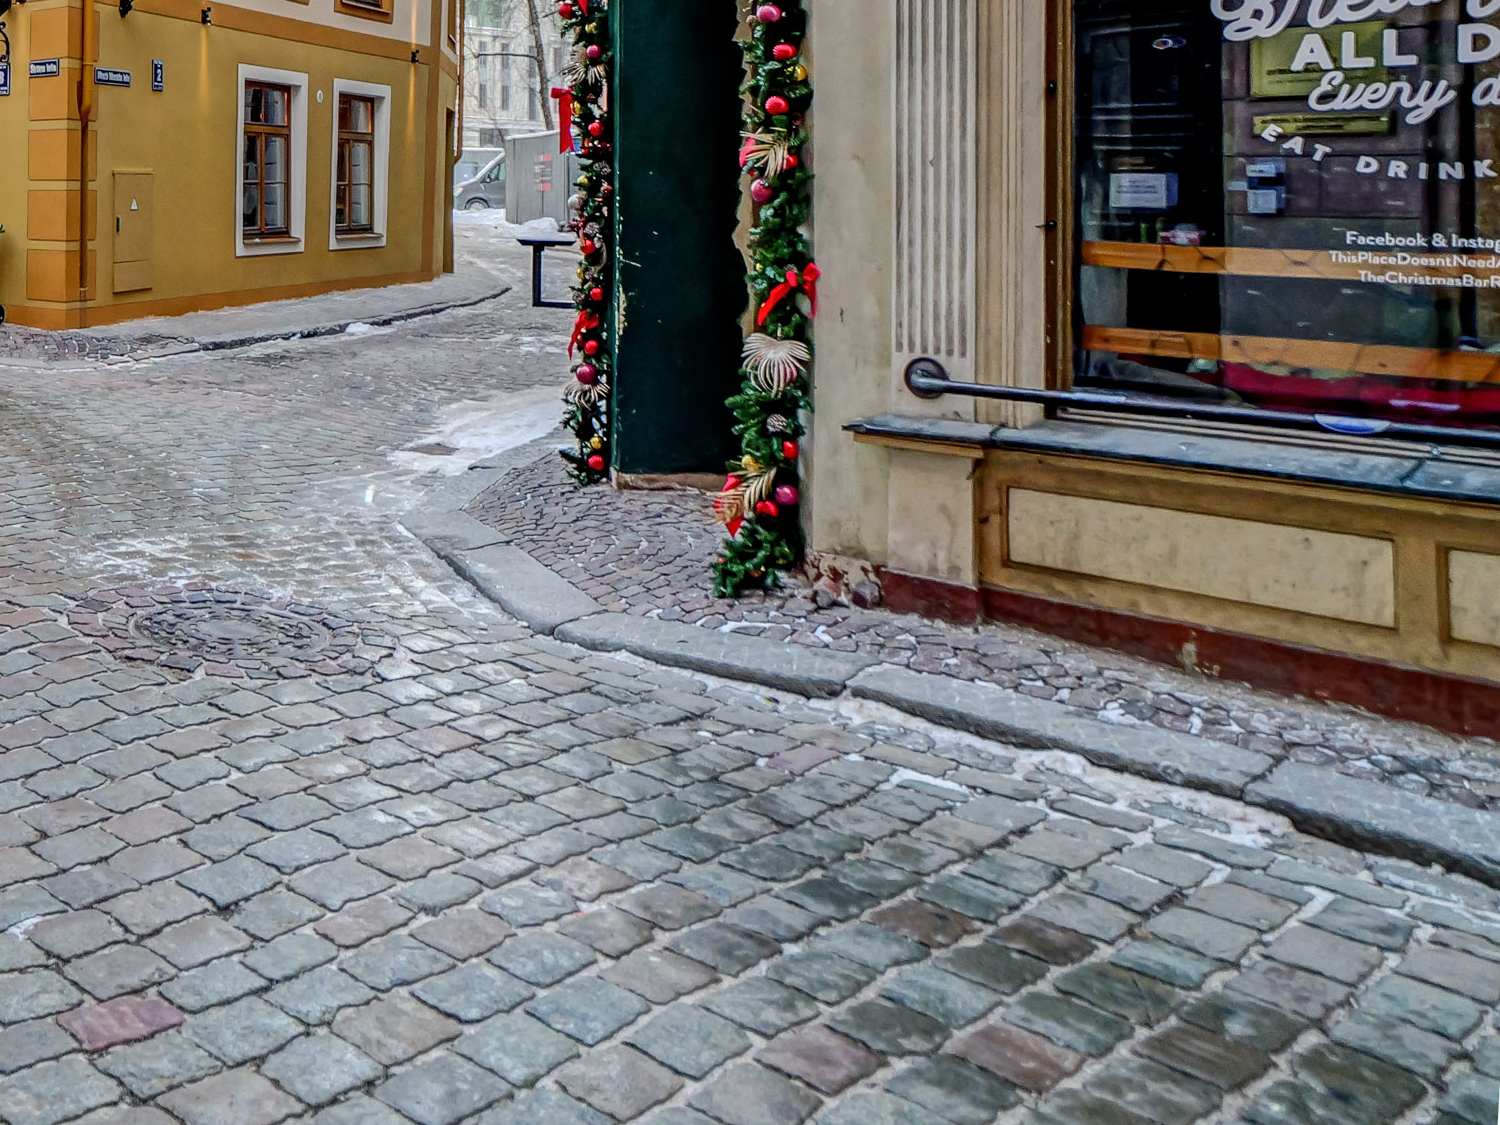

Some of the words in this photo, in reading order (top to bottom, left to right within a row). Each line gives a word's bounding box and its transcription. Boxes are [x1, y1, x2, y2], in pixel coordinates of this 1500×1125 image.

[1290, 28, 1420, 72] ALL
[1308, 70, 1457, 124] Every
[1261, 123, 1333, 163] EAT
[1356, 155, 1497, 179] DRINK
[1345, 231, 1428, 247] Facebook
[1432, 233, 1448, 247] &
